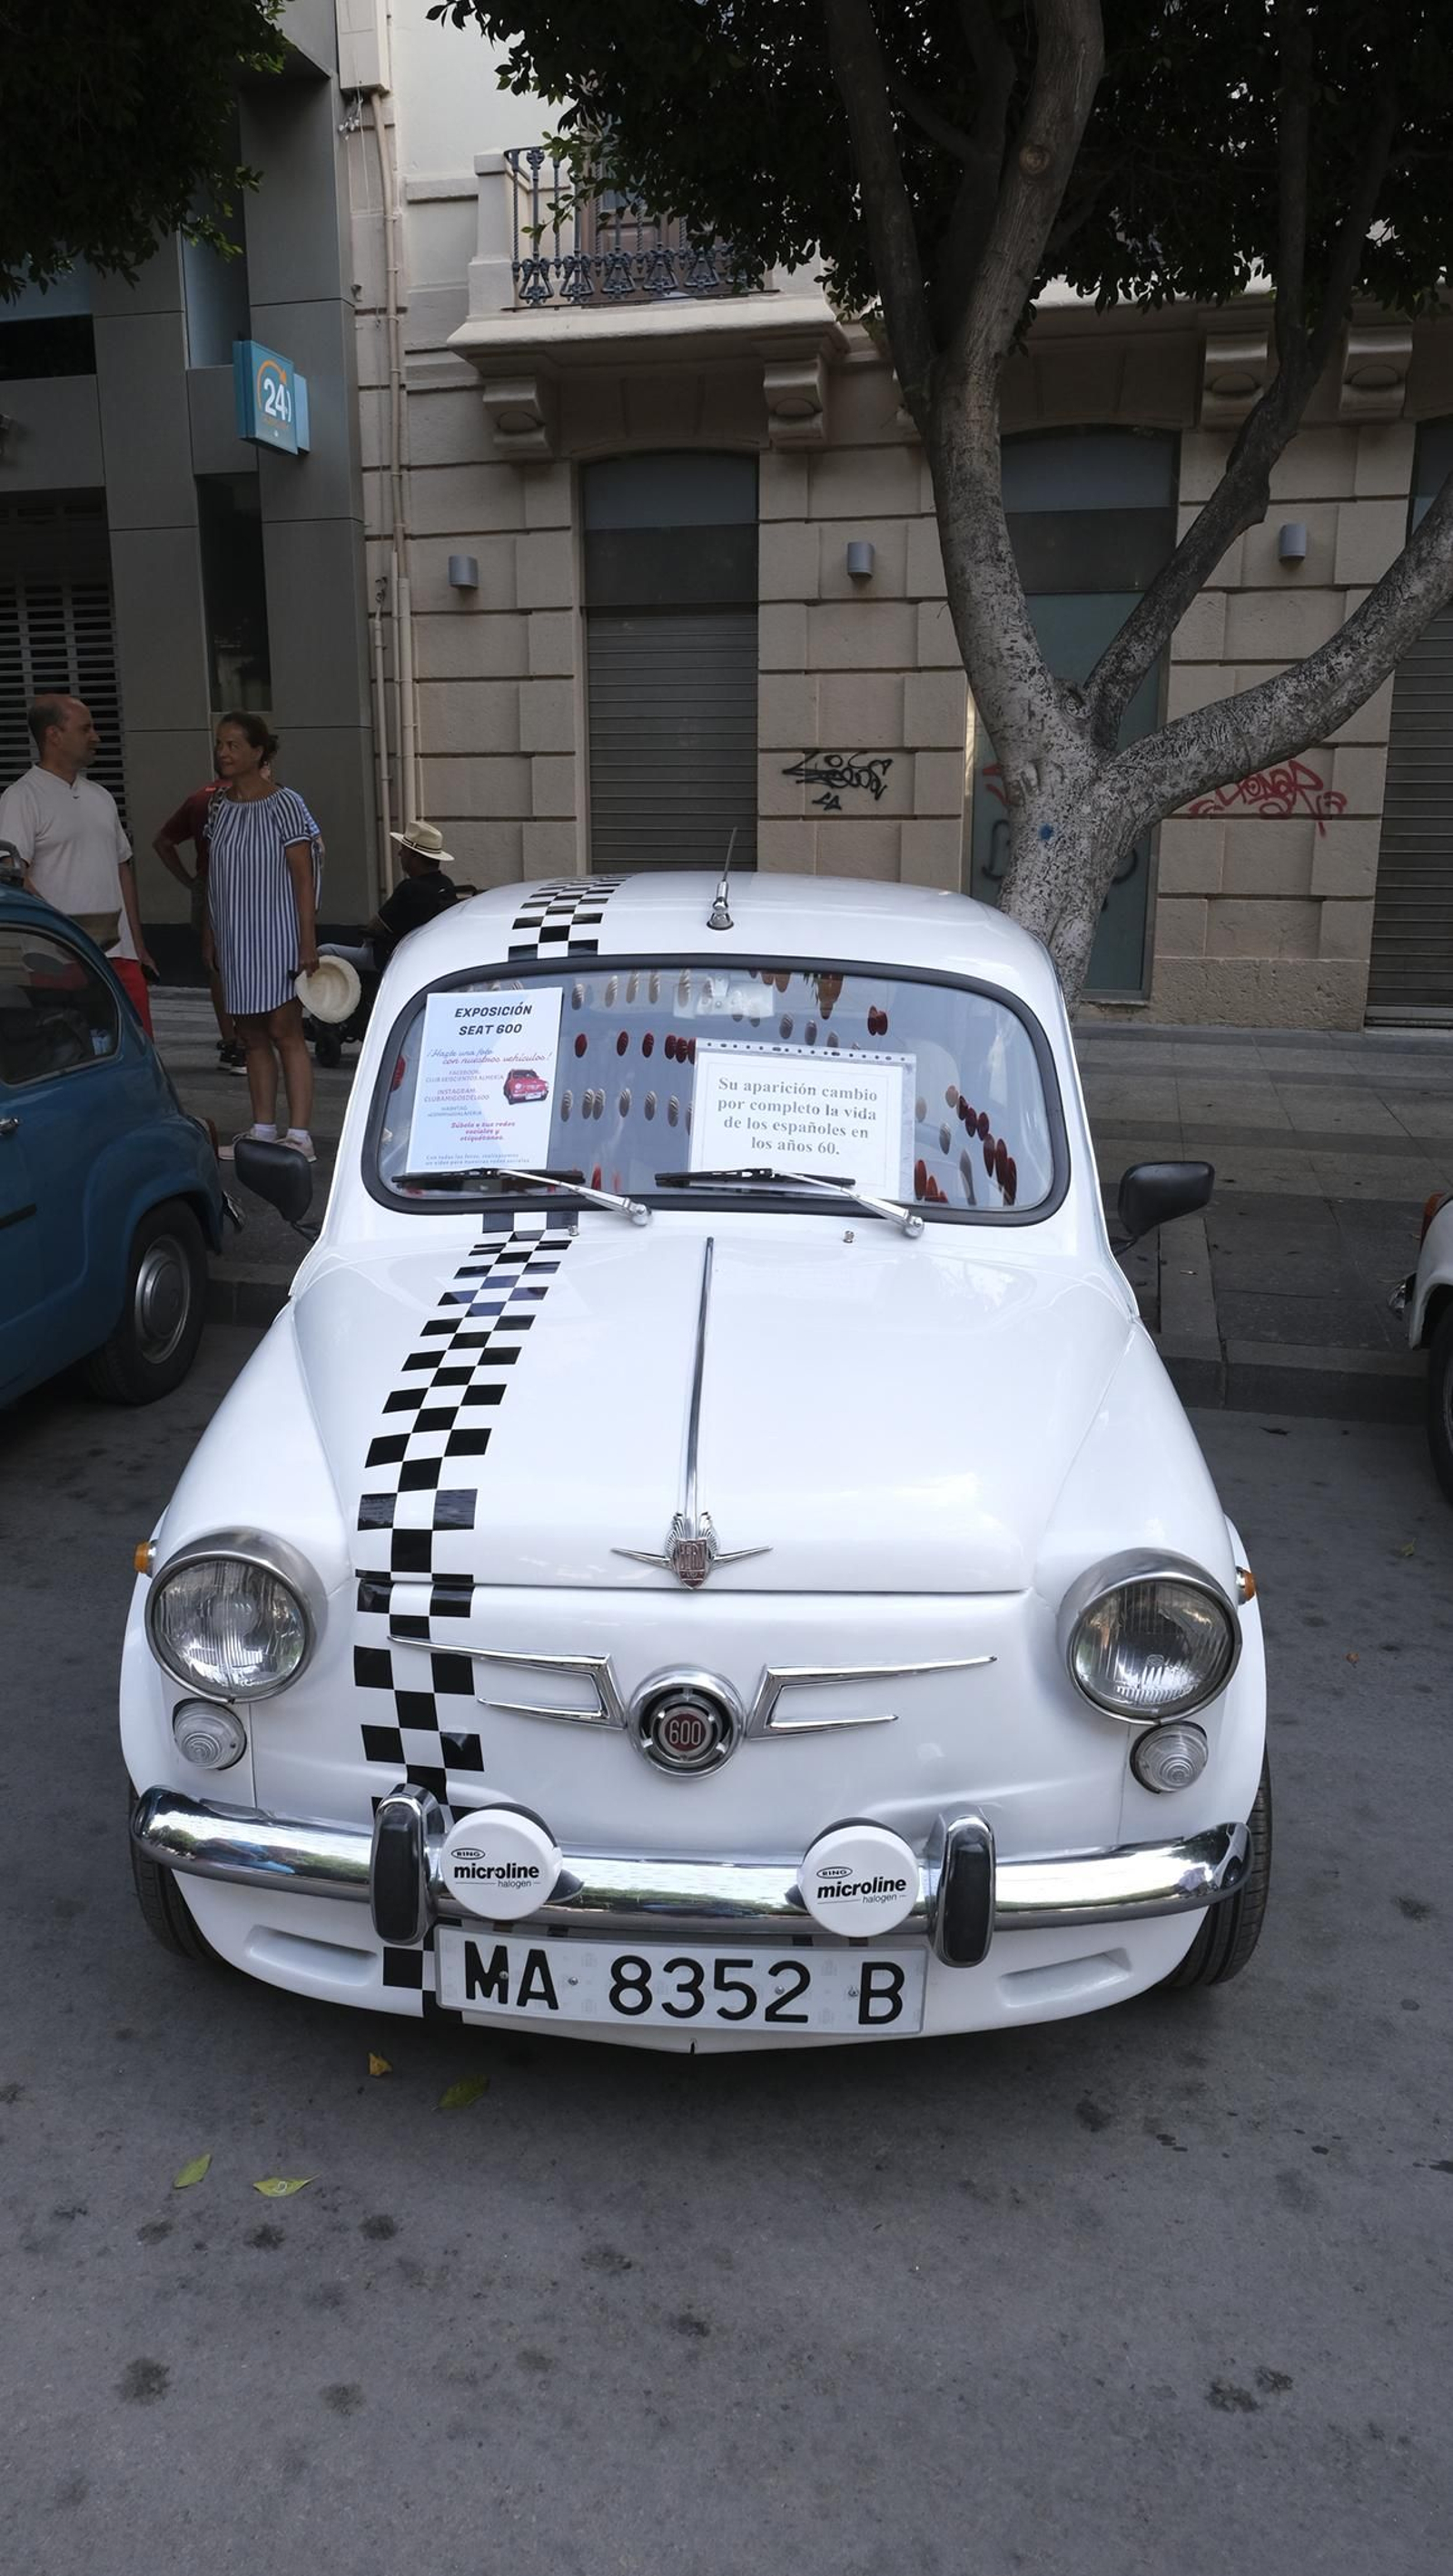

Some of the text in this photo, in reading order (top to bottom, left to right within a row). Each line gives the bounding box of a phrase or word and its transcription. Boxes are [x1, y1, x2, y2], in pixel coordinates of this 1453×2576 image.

[454, 1002, 533, 1018] EXPOSICIÓN
[459, 1023, 523, 1036] SEAT 600
[460, 1055, 500, 1064] nuestros
[718, 1077, 878, 1102] Su aparición cambio
[717, 1098, 877, 1120] por completo la vida
[724, 1116, 869, 1140] de los españoles en
[751, 1137, 841, 1156] los años 60.
[669, 1719, 702, 1746] 600
[454, 1862, 540, 1880] microline
[497, 1880, 532, 1890] halogen
[817, 1876, 907, 1900] microline
[862, 1893, 898, 1904] halogen
[464, 1939, 906, 2026] MA 8352 B
